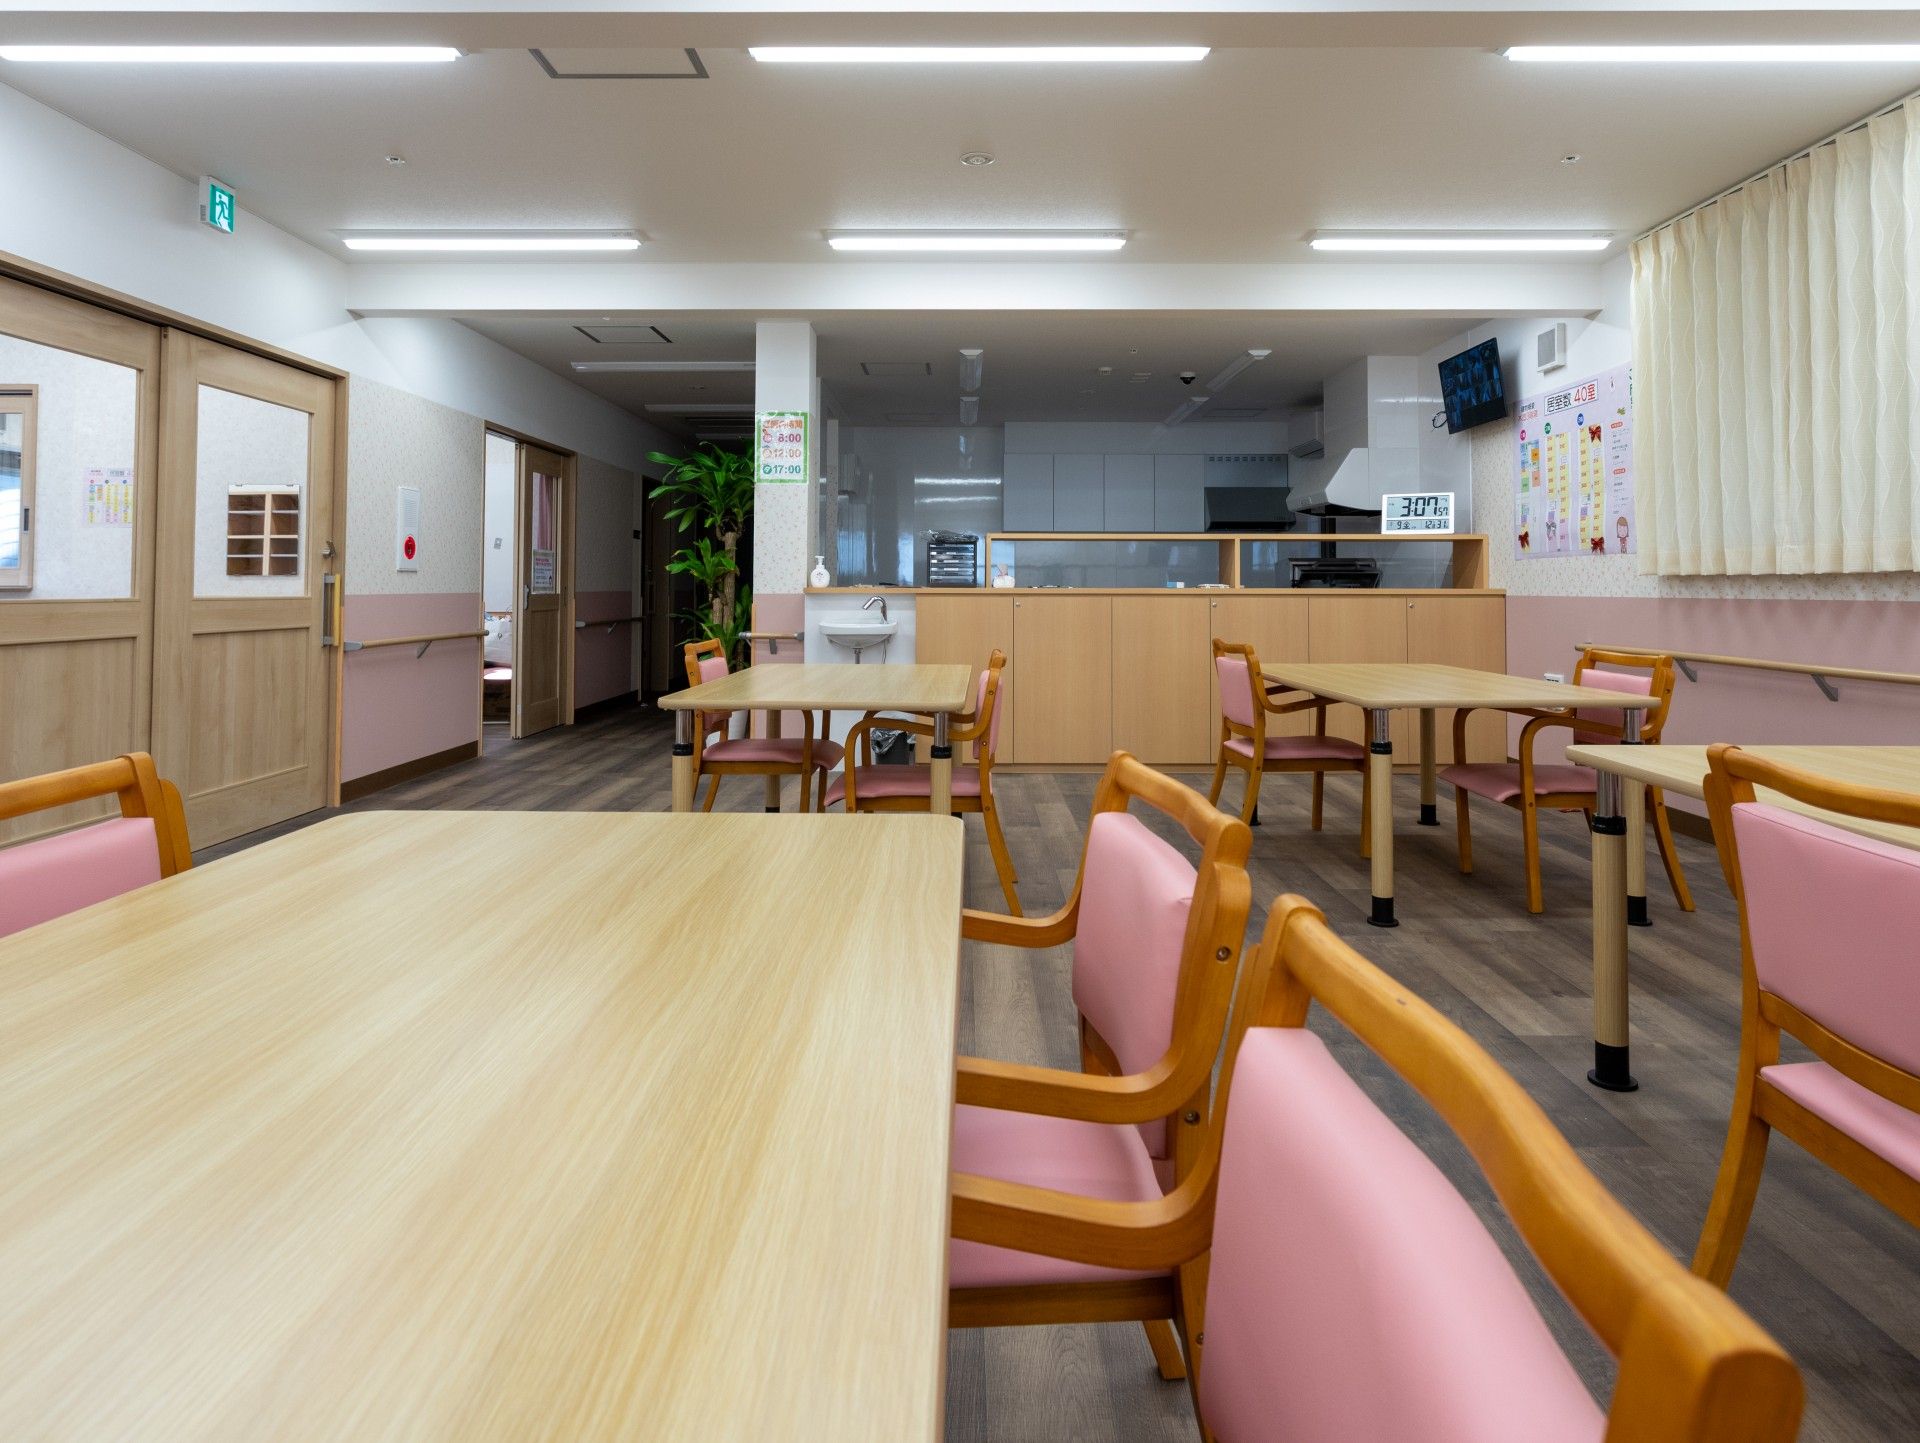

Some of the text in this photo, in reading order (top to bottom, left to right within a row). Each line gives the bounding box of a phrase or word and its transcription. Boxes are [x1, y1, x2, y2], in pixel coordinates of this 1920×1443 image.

[1574, 383, 1596, 403] 40室
[778, 434, 801, 442] 8:00
[774, 449, 801, 457] 12:00
[773, 465, 801, 473] 17:00
[1400, 496, 1439, 517] 3:07
